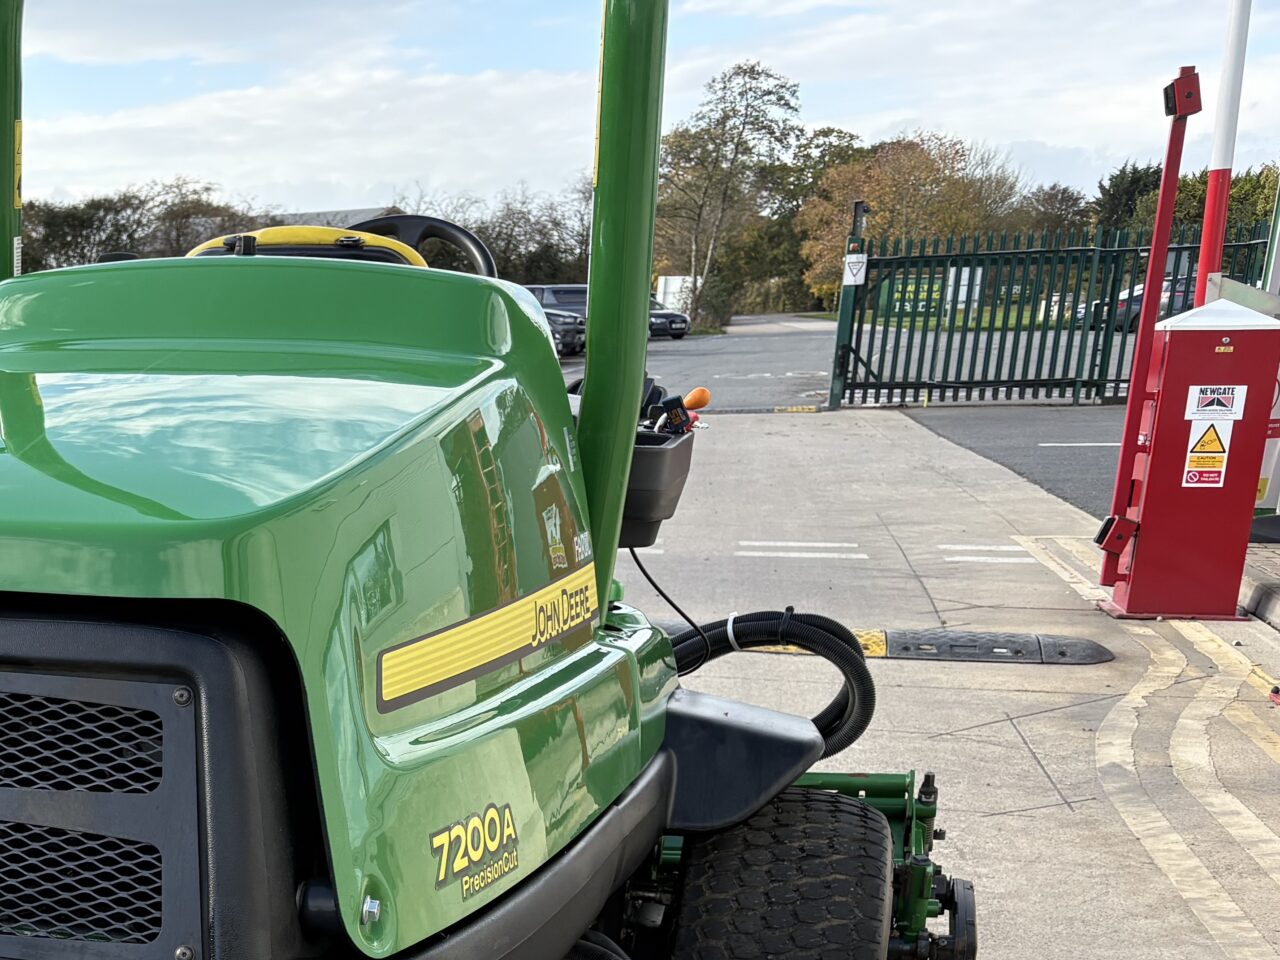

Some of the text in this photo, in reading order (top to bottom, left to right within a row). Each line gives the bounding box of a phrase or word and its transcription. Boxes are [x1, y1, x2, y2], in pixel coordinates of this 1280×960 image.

[1199, 387, 1236, 396] NEWGATE
[531, 585, 591, 644] JOHN DEERE
[432, 807, 516, 882] 7200A
[462, 848, 518, 898] PrecisionCut
